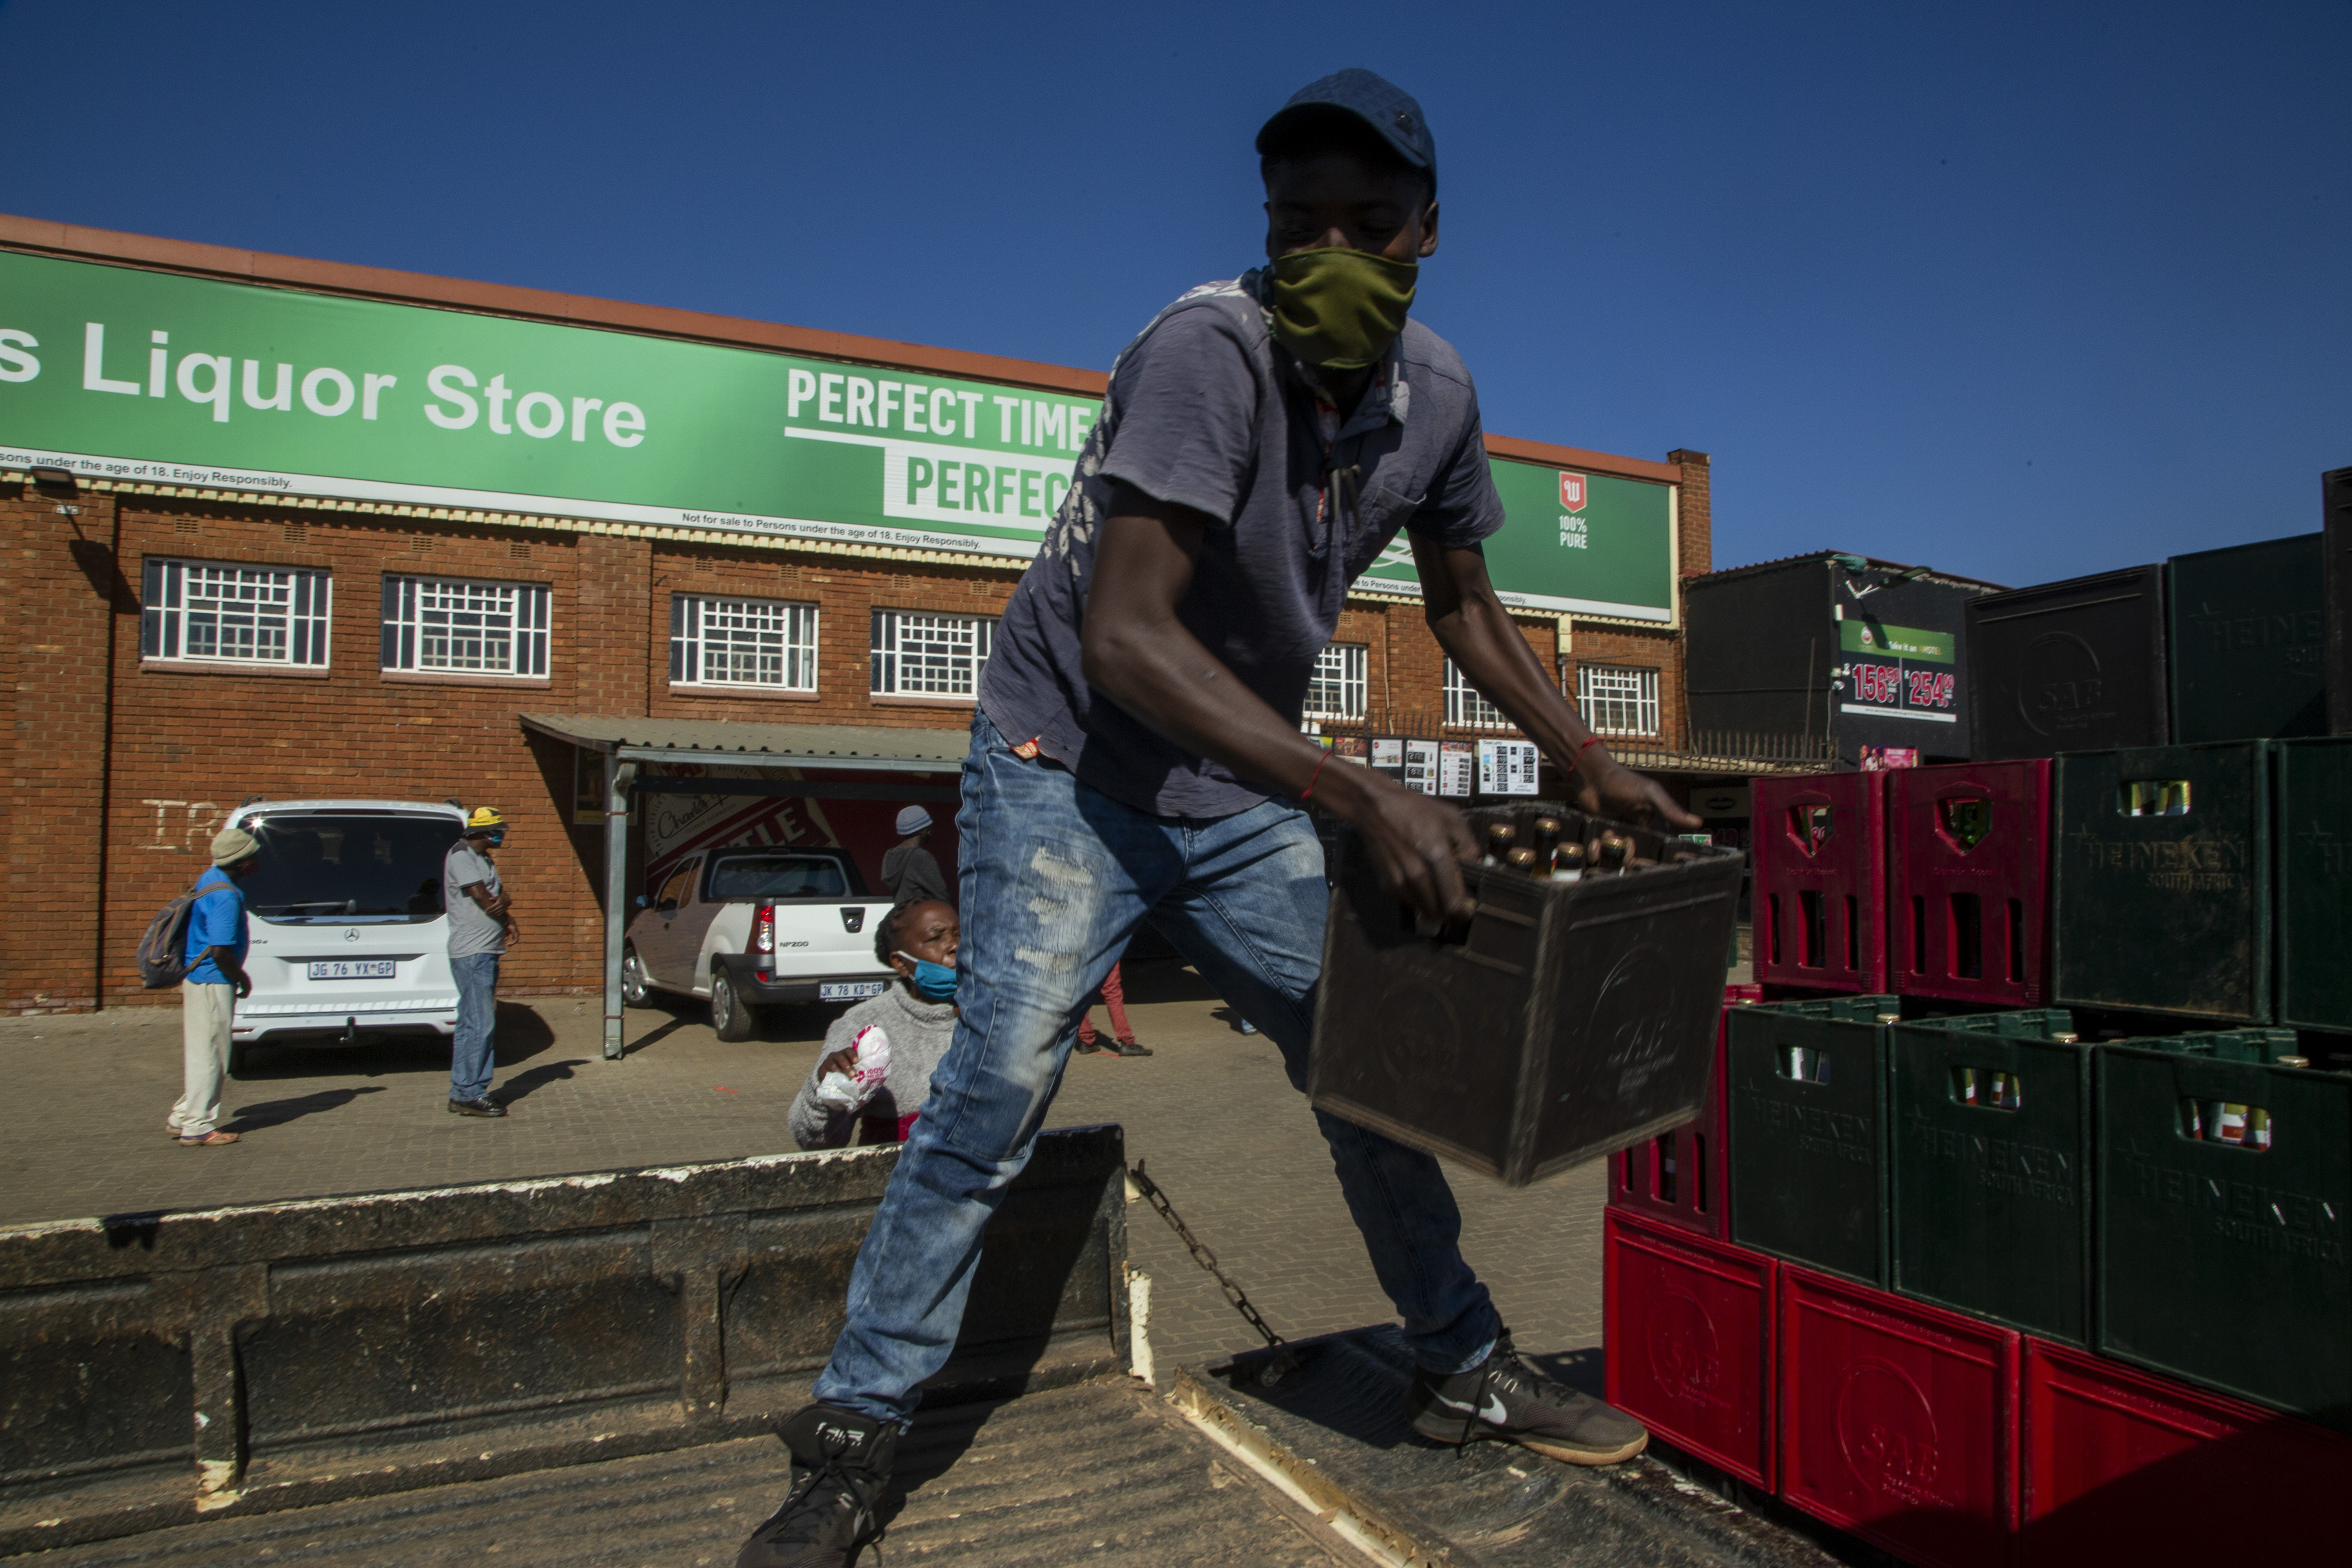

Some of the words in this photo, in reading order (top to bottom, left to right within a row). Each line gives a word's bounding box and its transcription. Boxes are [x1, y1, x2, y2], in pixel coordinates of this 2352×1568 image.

[83, 322, 398, 423] Liquor
[423, 364, 646, 448] Store
[787, 368, 984, 439] PERFECT
[992, 394, 1091, 452] TIME
[36, 455, 76, 469] under
[80, 459, 102, 471] the
[105, 465, 130, 477] age
[133, 465, 149, 475] of
[150, 466, 169, 477] 18.
[173, 468, 209, 483] Enjoy
[212, 471, 293, 489] Responsibly.
[907, 456, 1073, 519] PERFEC
[682, 512, 700, 523] Not
[703, 514, 717, 525] for
[719, 516, 741, 528] sale
[743, 518, 754, 528] to
[756, 519, 796, 532] Persons
[799, 523, 827, 535] under
[830, 526, 846, 536] the
[847, 529, 865, 539] age
[867, 528, 878, 538] of
[880, 530, 893, 540] 18.
[895, 532, 920, 545] Enjoy
[922, 534, 981, 550] Responsibly.
[1559, 515, 1588, 533] 100%
[1560, 531, 1588, 549] PURE
[1370, 580, 1399, 590] Persons
[1400, 584, 1421, 593] under
[312, 963, 327, 976] JG
[333, 963, 347, 975] 76
[354, 962, 369, 975] YX
[377, 962, 392, 975] GP
[821, 986, 832, 996] JK
[838, 985, 849, 996] 78
[853, 984, 864, 995] KD
[871, 984, 882, 995] GP
[1750, 1095, 1871, 1144] HEINEKEN
[1916, 1124, 2073, 1183] HEINEKEN
[2135, 1162, 2344, 1237] HEINEKEN
[2212, 1215, 2272, 1250] SOUTH
[2280, 1229, 2343, 1267] AFRICA
